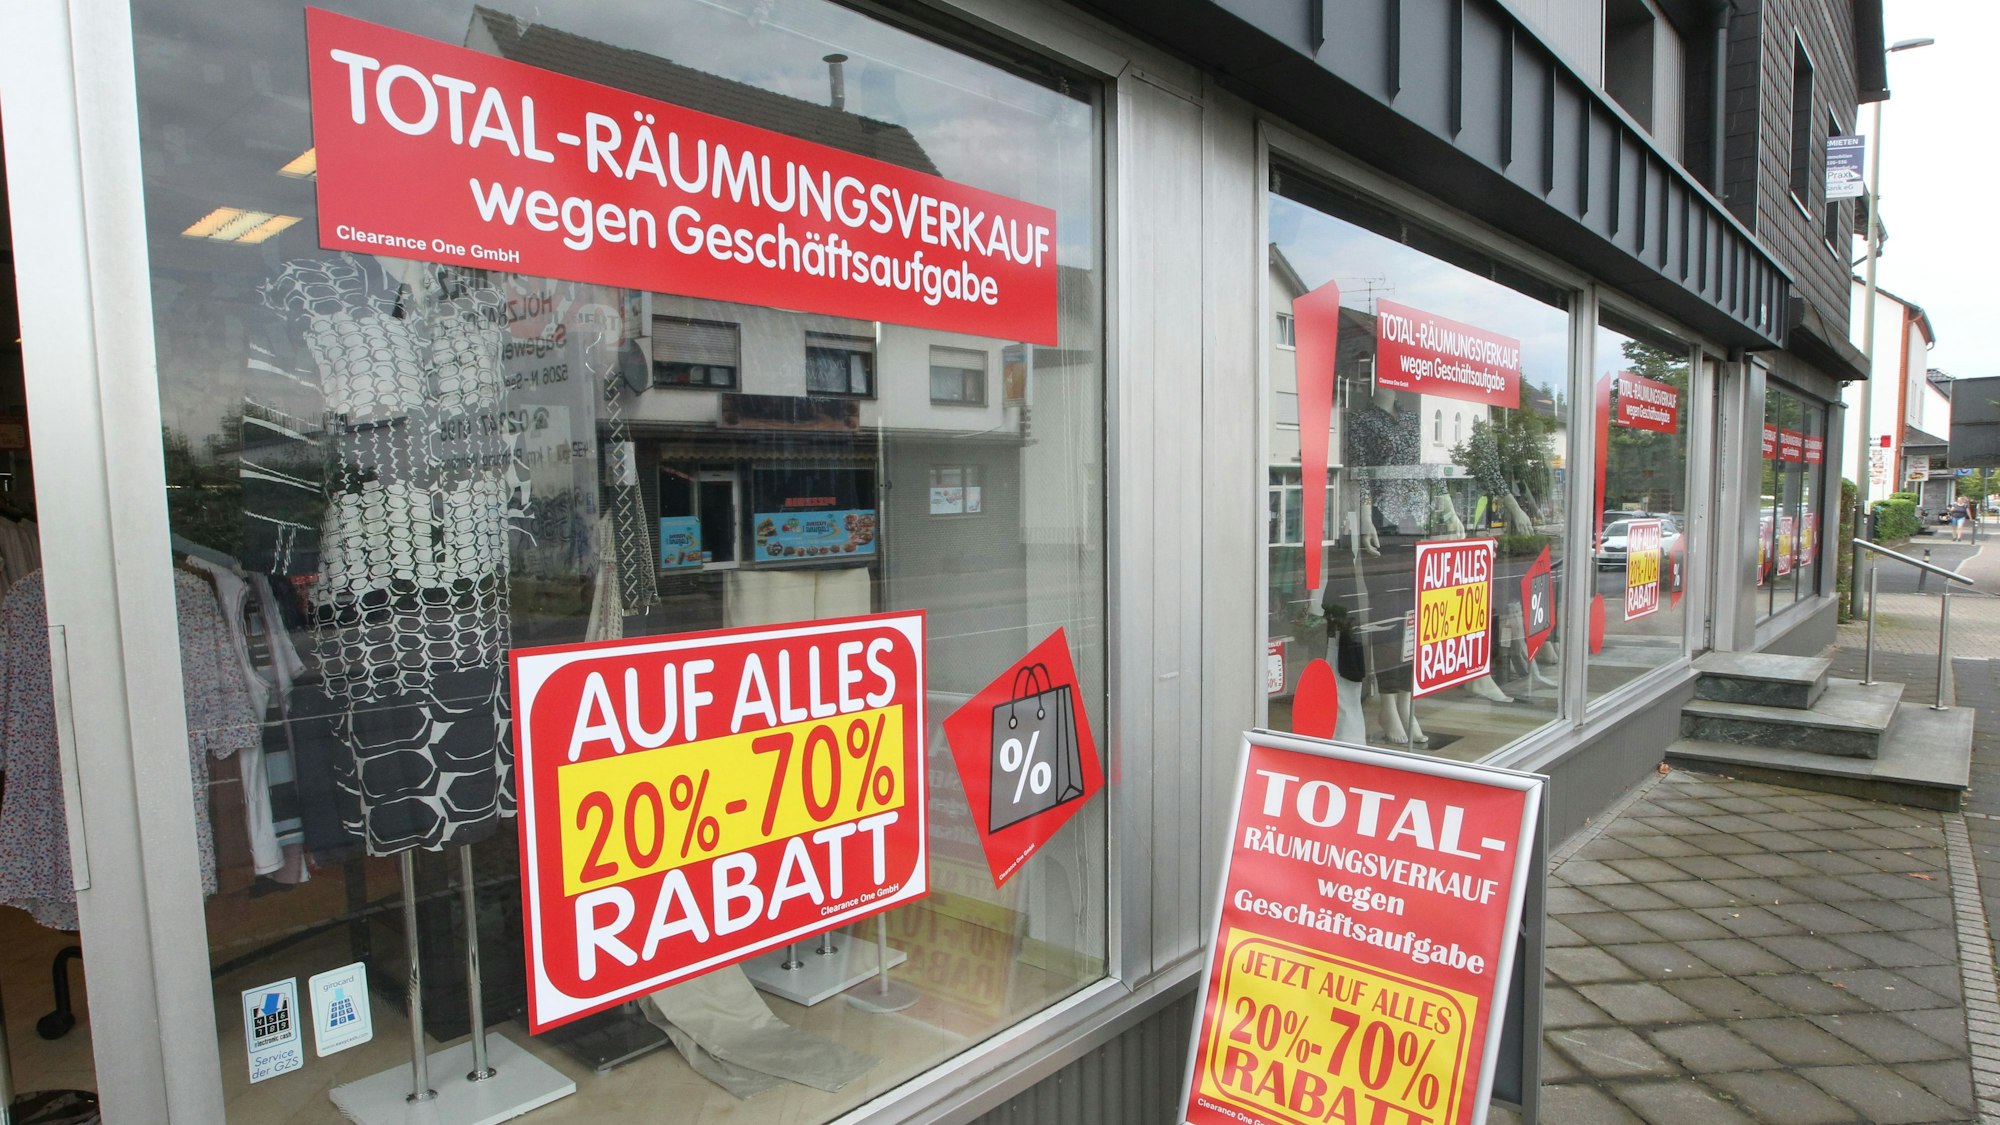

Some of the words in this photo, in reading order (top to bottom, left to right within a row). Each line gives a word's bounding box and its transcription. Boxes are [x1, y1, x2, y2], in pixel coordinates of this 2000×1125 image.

[331, 49, 1048, 268] TOTAL-RÄUMUNGSVERKAUF
[336, 224, 427, 250] Clearance
[431, 238, 465, 257] One
[470, 243, 520, 264] GmbH
[471, 178, 656, 252] wegen
[667, 205, 998, 306] Geschäftsaufgabe
[1380, 311, 1519, 371] TOTAL-RÄUMUNGSVERKAUF
[1400, 354, 1433, 381] wegen
[1434, 357, 1505, 394] Geschäftsaufgabe
[1423, 551, 1451, 590] AUF
[1453, 549, 1487, 586] ALLES
[1423, 584, 1485, 642] 20%-70%
[1627, 582, 1657, 612] RABATT
[1420, 631, 1485, 682] RABATT
[568, 659, 713, 761] AUF
[730, 637, 895, 732] ALLES
[575, 714, 894, 883] 20%-70%
[1256, 769, 1506, 860] TOTAL-
[1243, 825, 1499, 904] RÄUMUNGSVERKAUF
[574, 811, 898, 981] RABATT
[820, 897, 858, 916] Clearance
[860, 892, 876, 906] One
[877, 882, 899, 900] GmbH
[1318, 879, 1404, 916] wegen
[1234, 889, 1484, 975] Geschäftsaufgabe
[323, 975, 354, 992] girocard
[1241, 950, 1315, 985] JETZT
[1318, 974, 1367, 1006] AUF
[1371, 988, 1452, 1035] ALLES
[255, 1049, 294, 1067] Service
[279, 1032, 292, 1041] cash
[1230, 996, 1440, 1110] 20%-70%
[252, 1067, 269, 1080] der
[274, 1056, 299, 1072] GZS
[1197, 1098, 1236, 1118] Clearance
[1237, 1112, 1253, 1124] One
